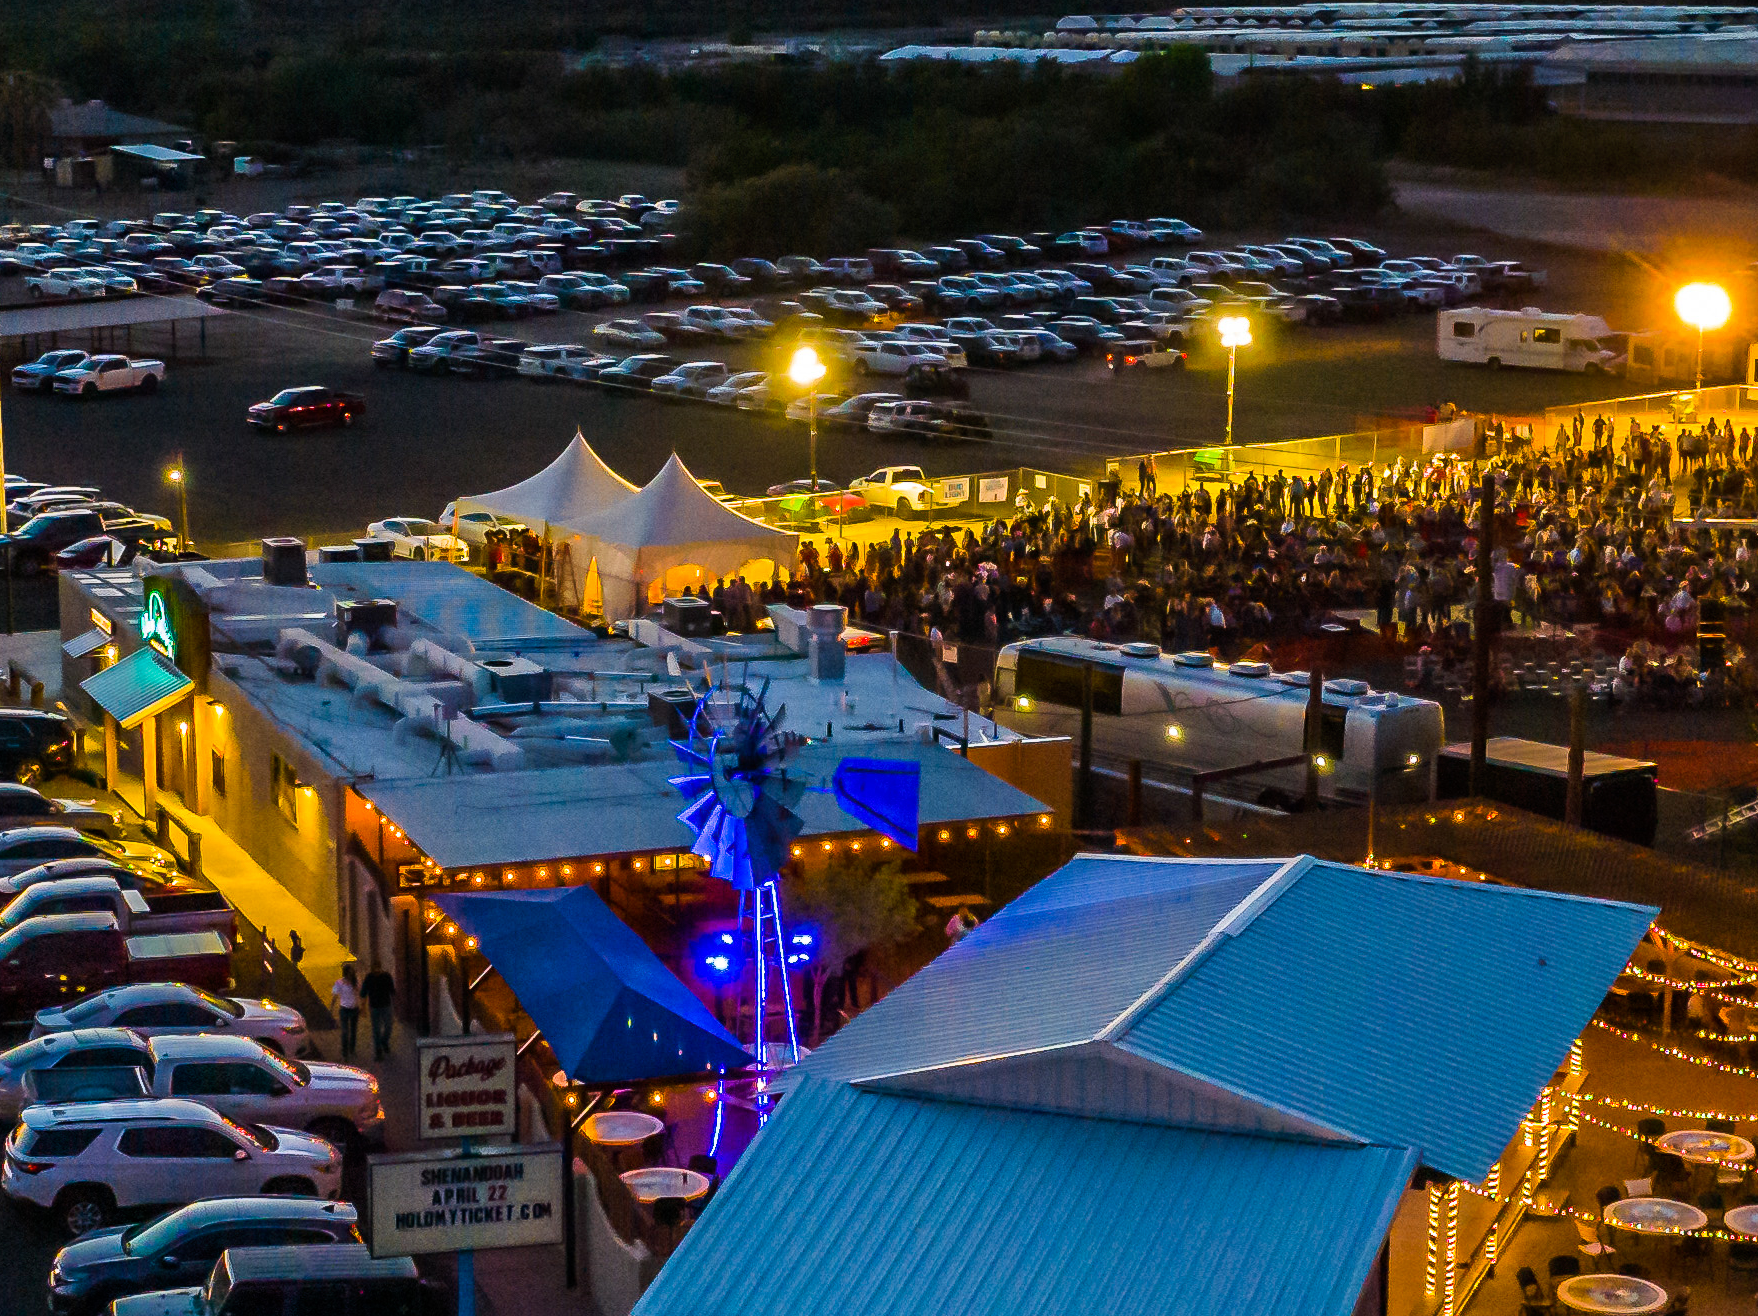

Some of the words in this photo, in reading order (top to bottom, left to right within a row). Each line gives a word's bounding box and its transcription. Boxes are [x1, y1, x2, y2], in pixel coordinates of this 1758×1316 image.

[428, 1056, 505, 1084] Package
[426, 1089, 507, 1108] LIQUOR
[429, 1112, 445, 1129] &
[452, 1111, 504, 1128] BEER
[421, 1163, 524, 1186] SHENANDOAH
[432, 1187, 480, 1206] APRIL
[487, 1185, 509, 1202] 22
